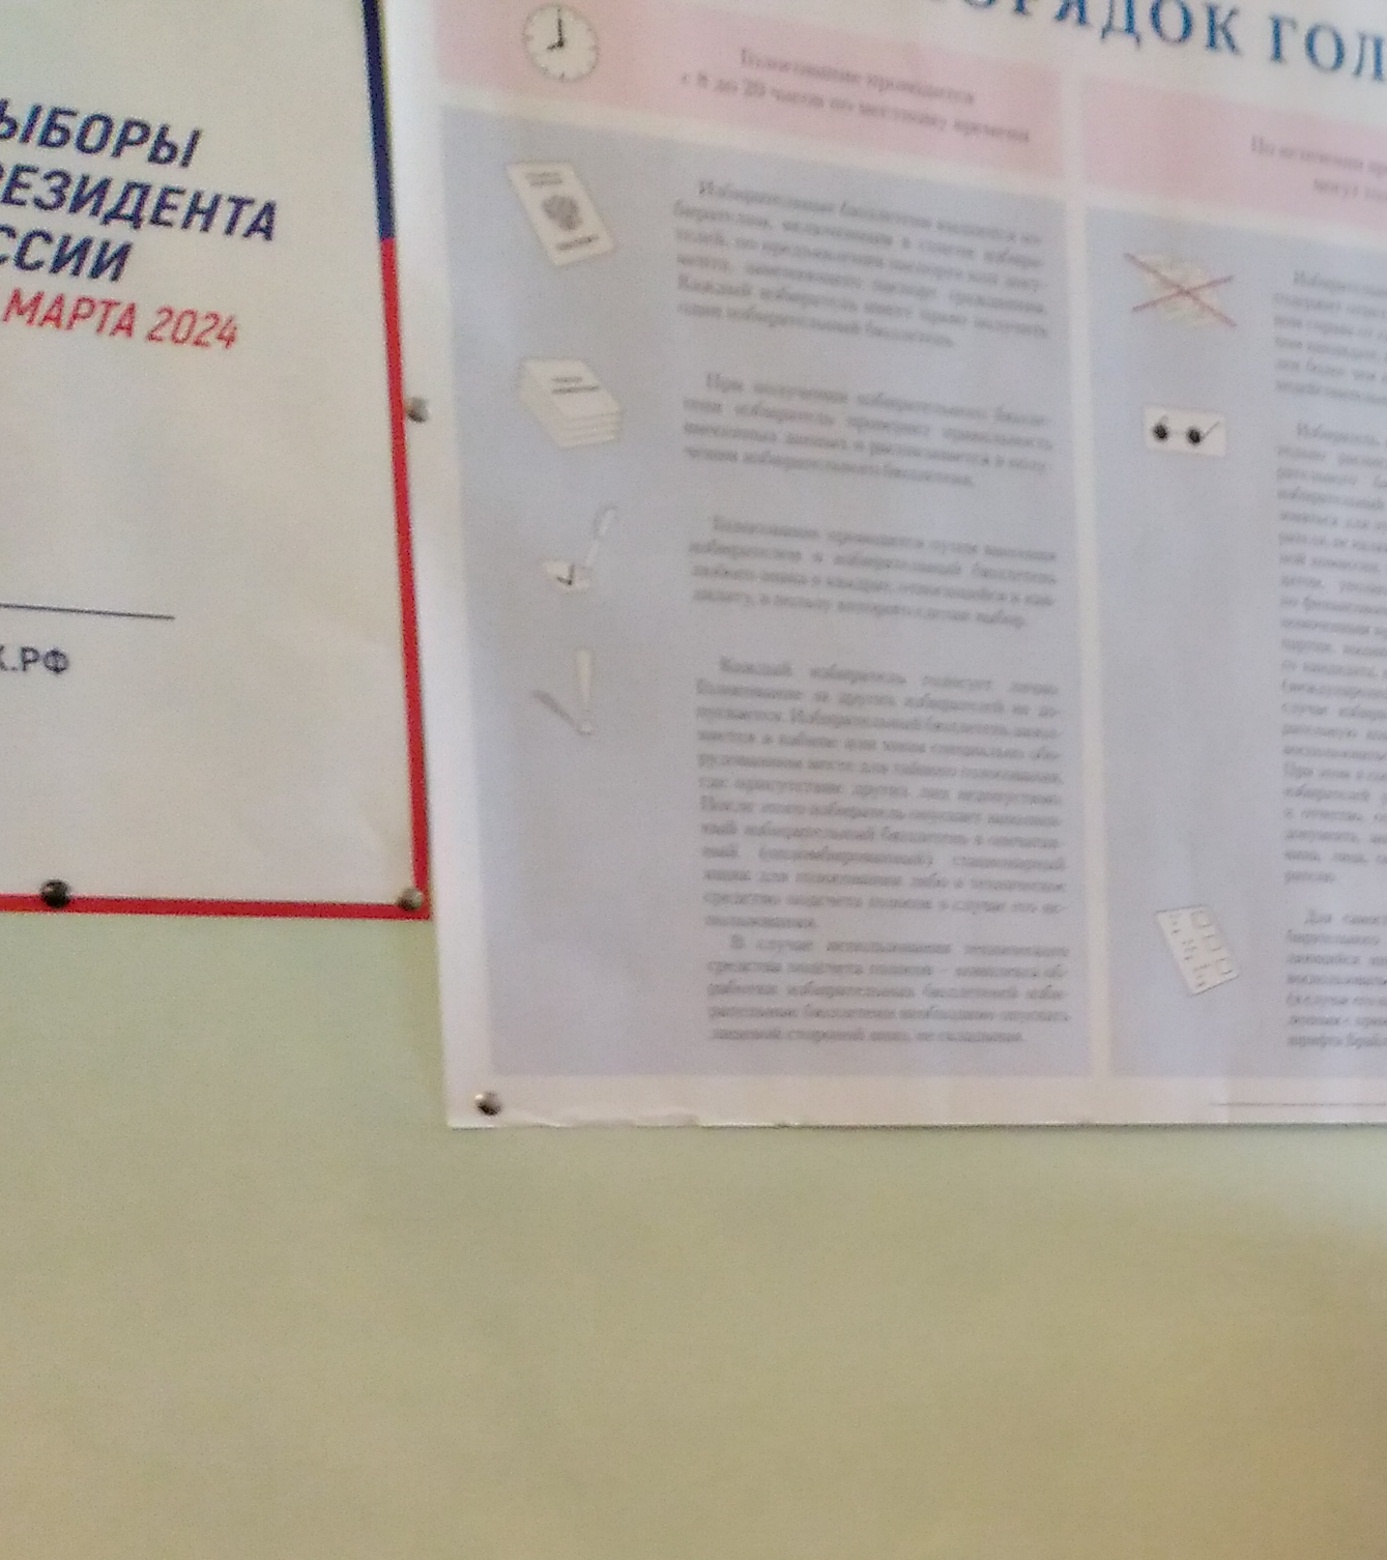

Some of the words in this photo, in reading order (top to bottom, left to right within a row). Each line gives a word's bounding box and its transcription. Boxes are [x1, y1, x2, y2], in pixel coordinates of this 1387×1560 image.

[963, 0, 1241, 55] ЯДОК
[0, 161, 277, 242] ЕЗИДЕНТА
[3, 288, 136, 338] МАРТА
[146, 305, 238, 349] 2024
